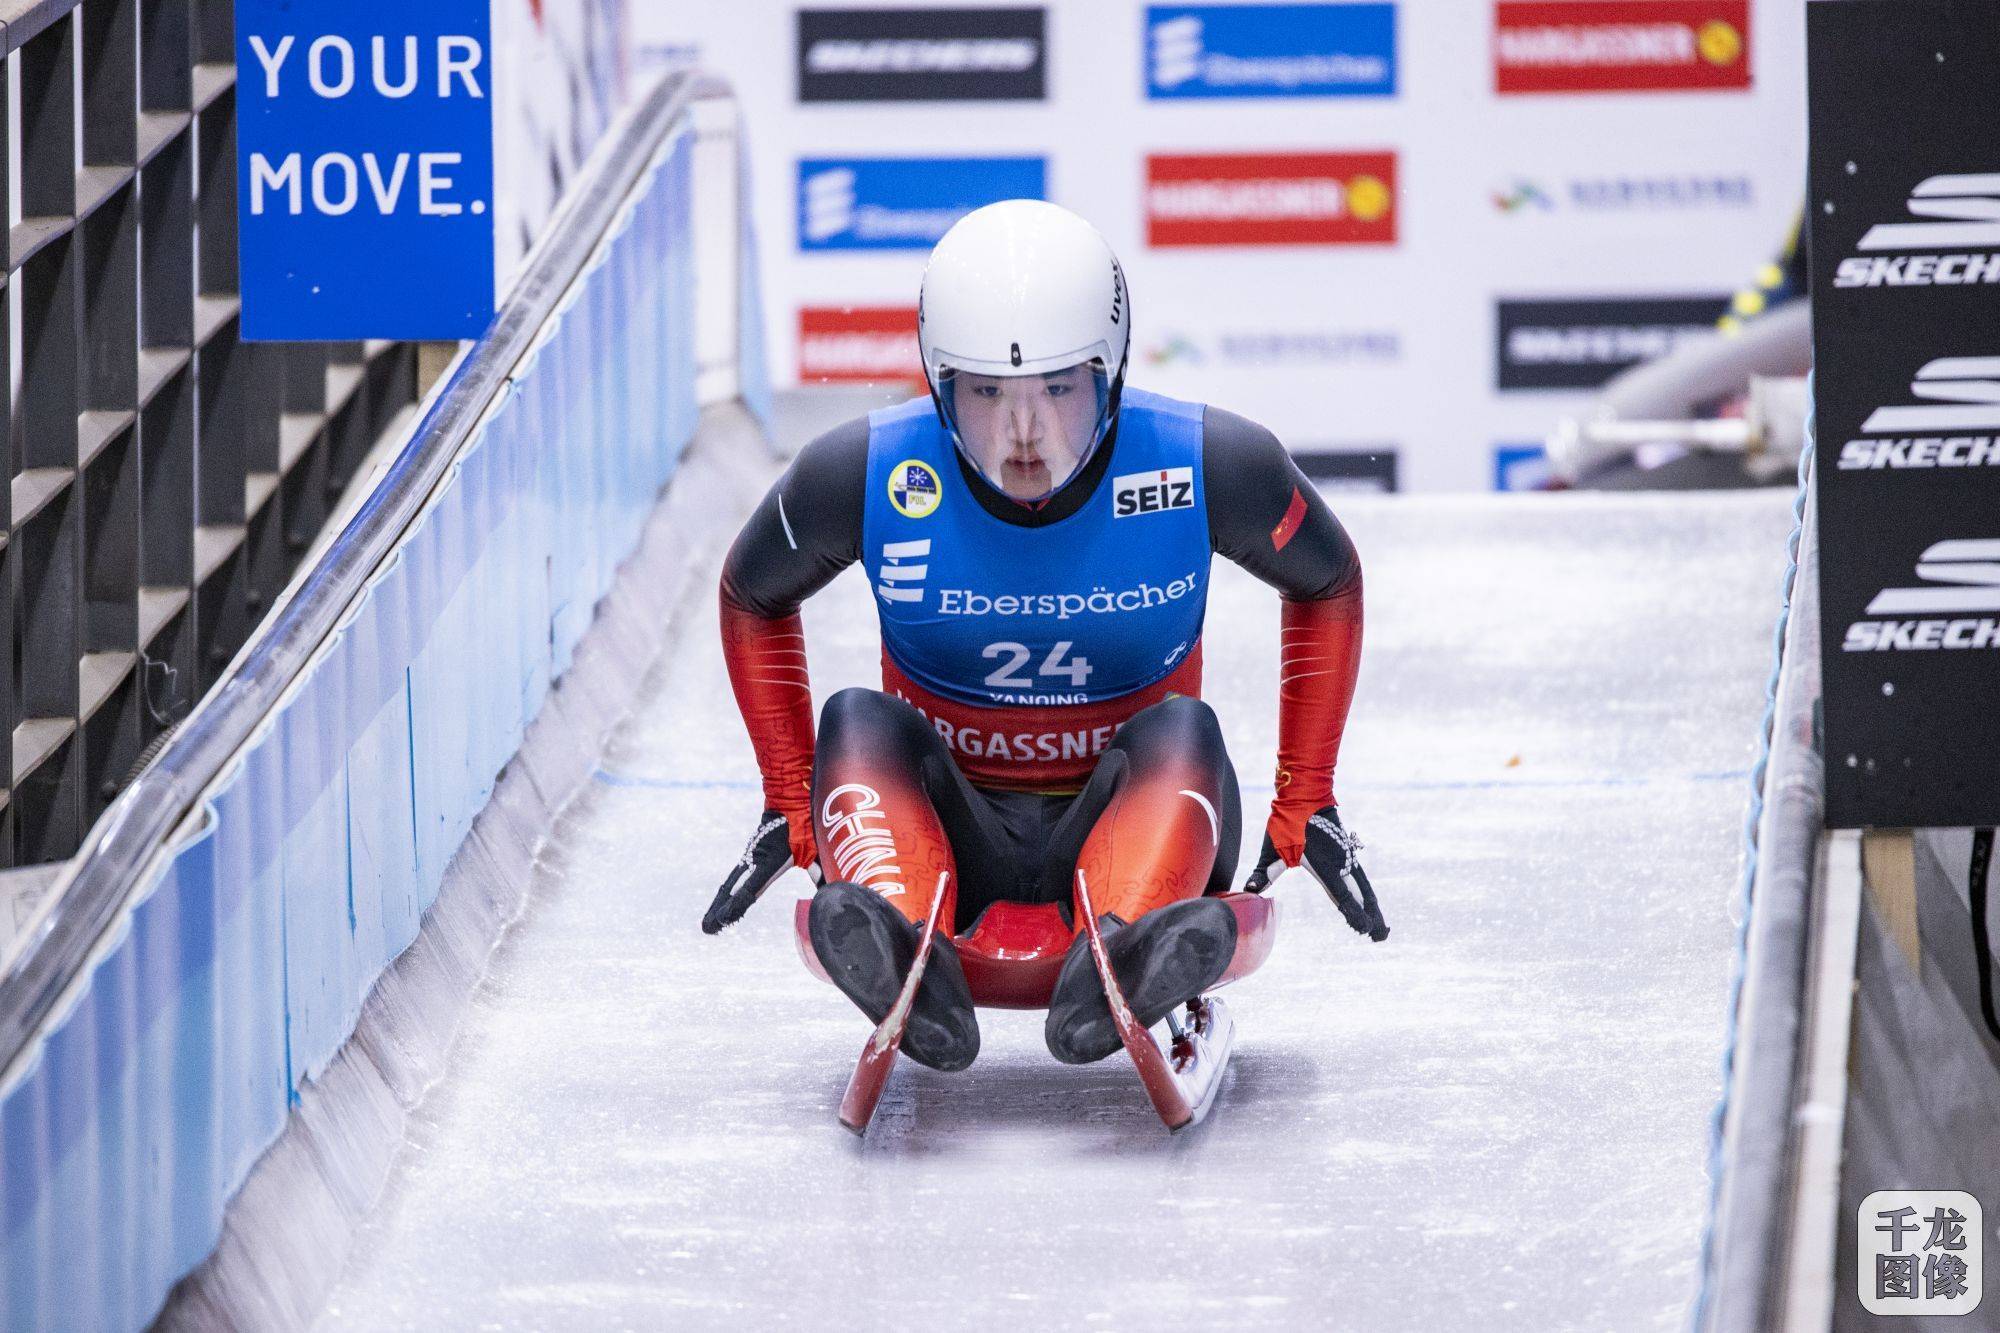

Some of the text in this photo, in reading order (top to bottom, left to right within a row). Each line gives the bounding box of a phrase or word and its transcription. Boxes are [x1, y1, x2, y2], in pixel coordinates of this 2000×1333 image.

[248, 35, 484, 98] YOUR
[250, 153, 486, 216] MOVE.
[1833, 253, 2000, 288] SKECH
[1837, 436, 2000, 470] SKECH
[938, 571, 1197, 619] Eberspächer
[981, 641, 1093, 688] 24
